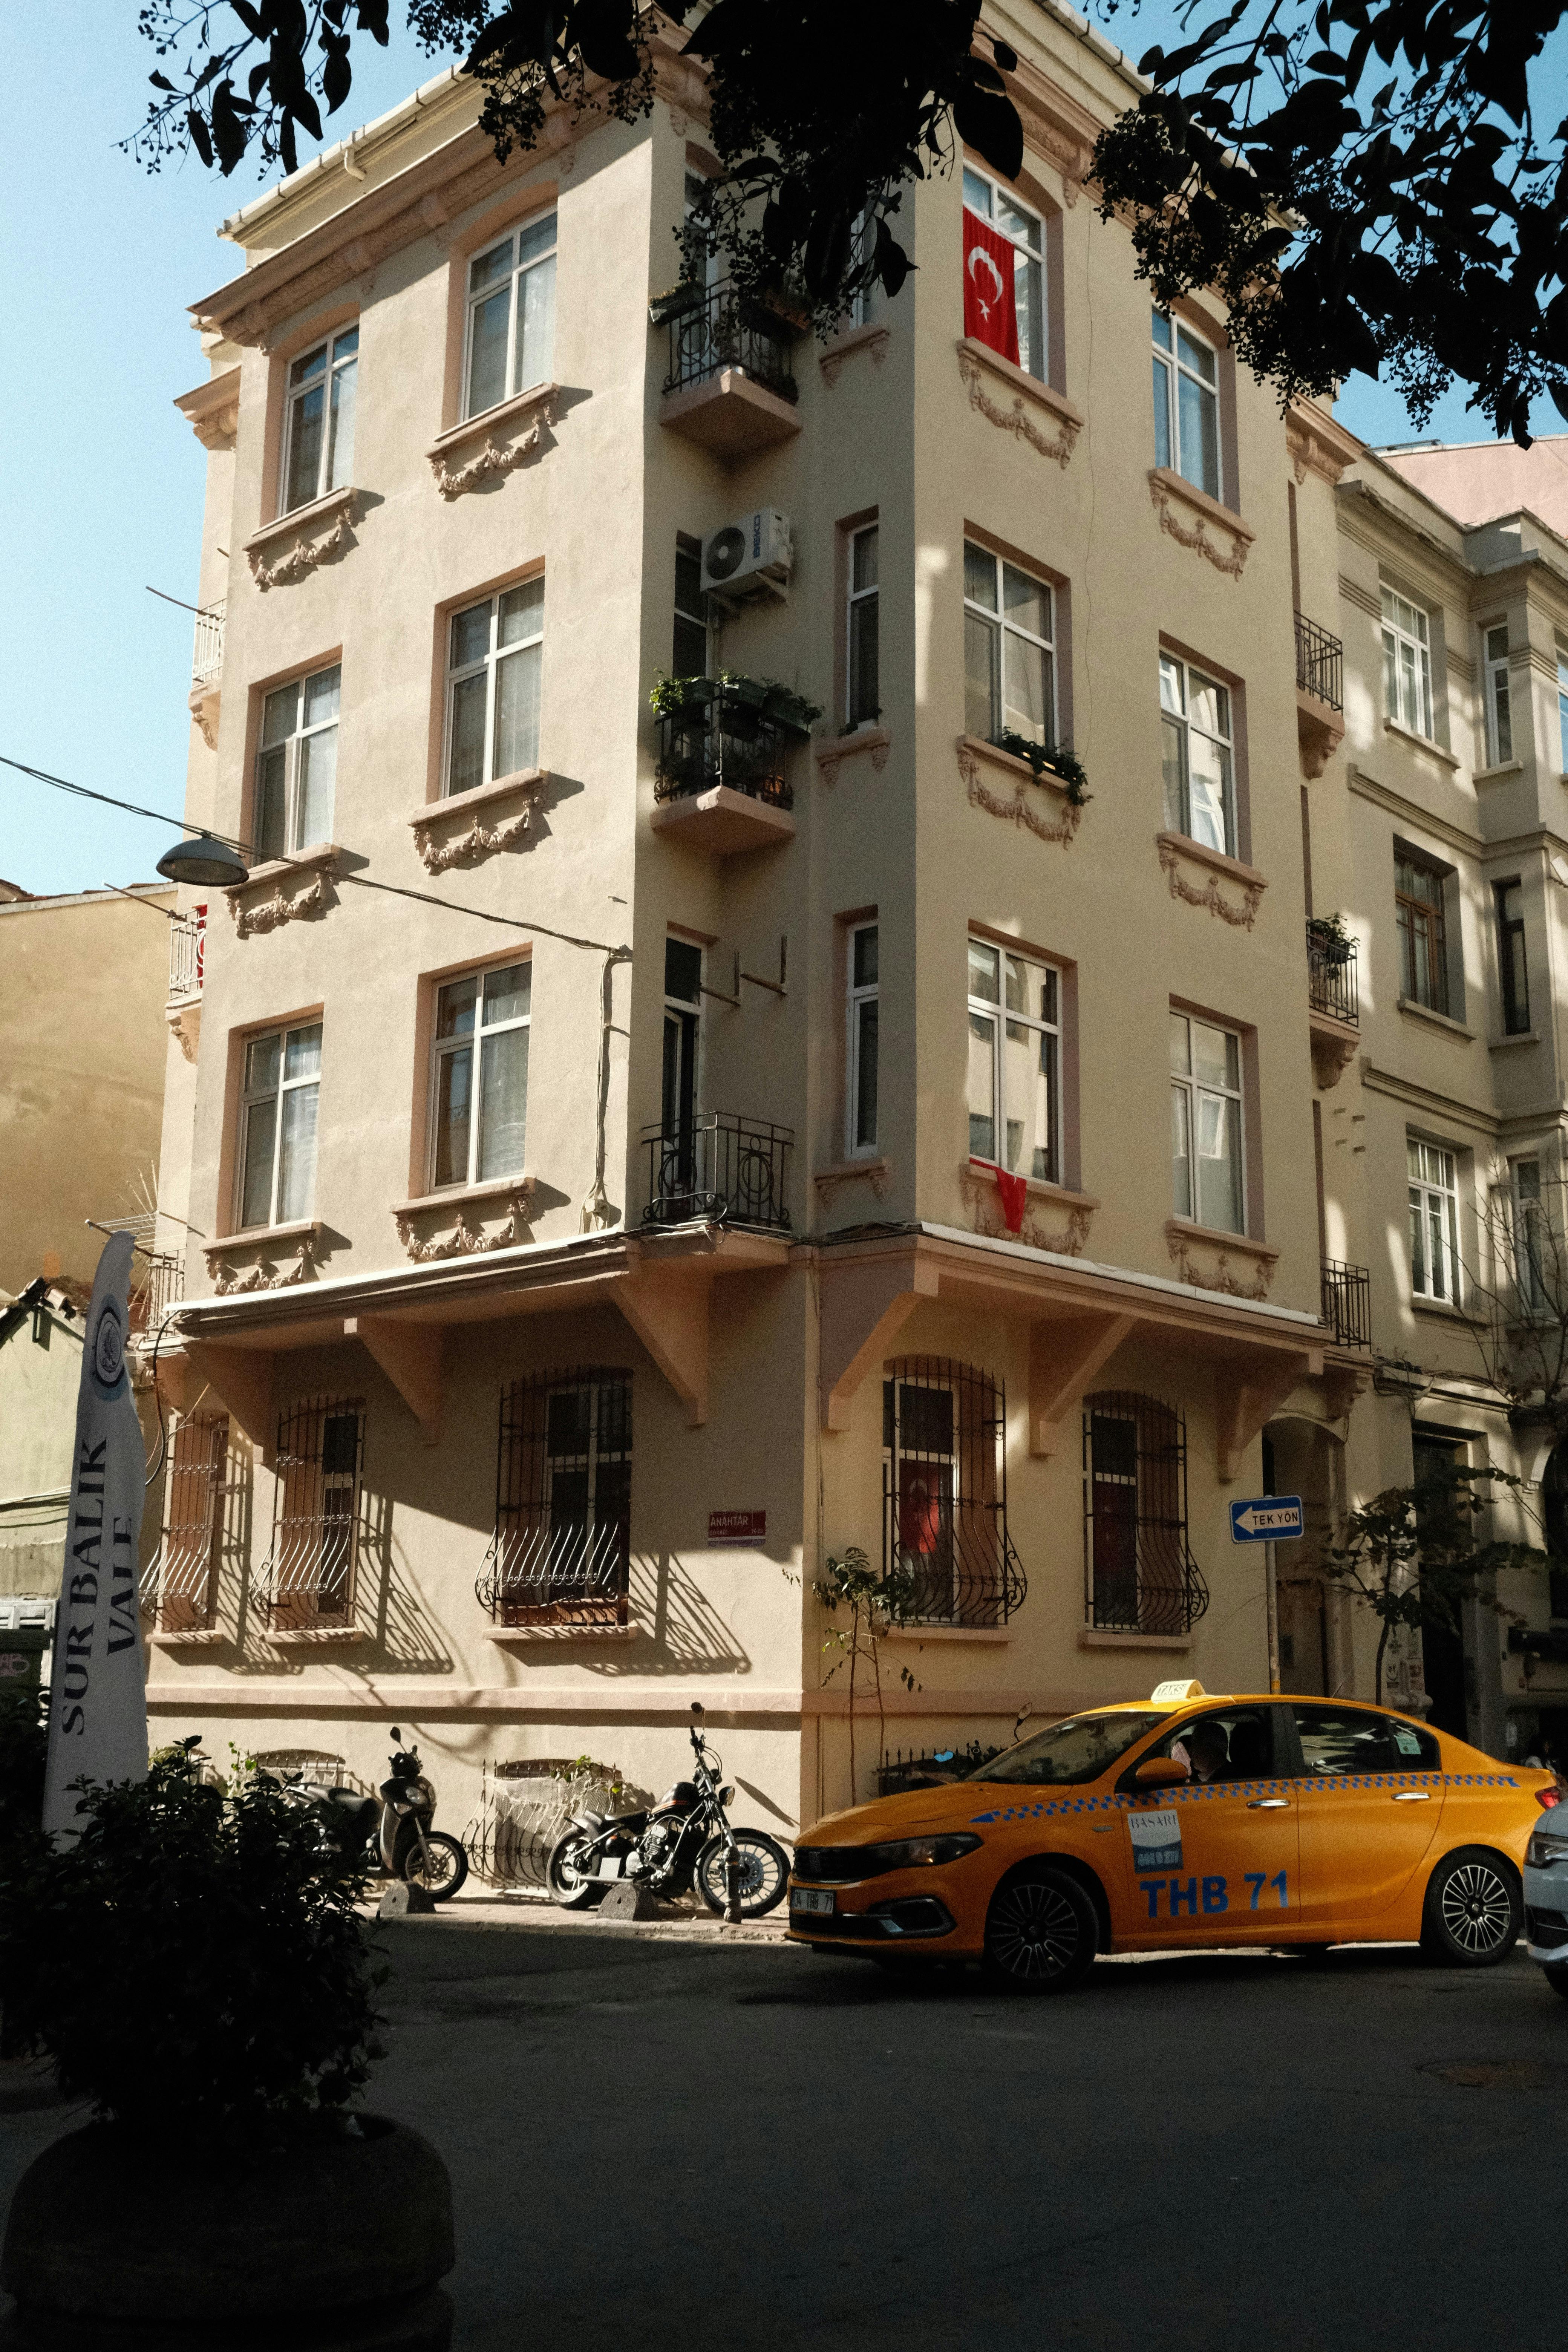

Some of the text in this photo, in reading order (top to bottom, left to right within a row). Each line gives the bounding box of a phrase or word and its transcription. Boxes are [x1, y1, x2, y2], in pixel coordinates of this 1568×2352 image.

[710, 1516, 748, 1527] ANAHTAR
[1253, 1511, 1298, 1525] TEK YÖN
[61, 1438, 107, 1736] SUR BALIK
[806, 1892, 819, 1909] THB
[824, 1894, 833, 1911] 71
[1140, 1870, 1289, 1918] THB 71
